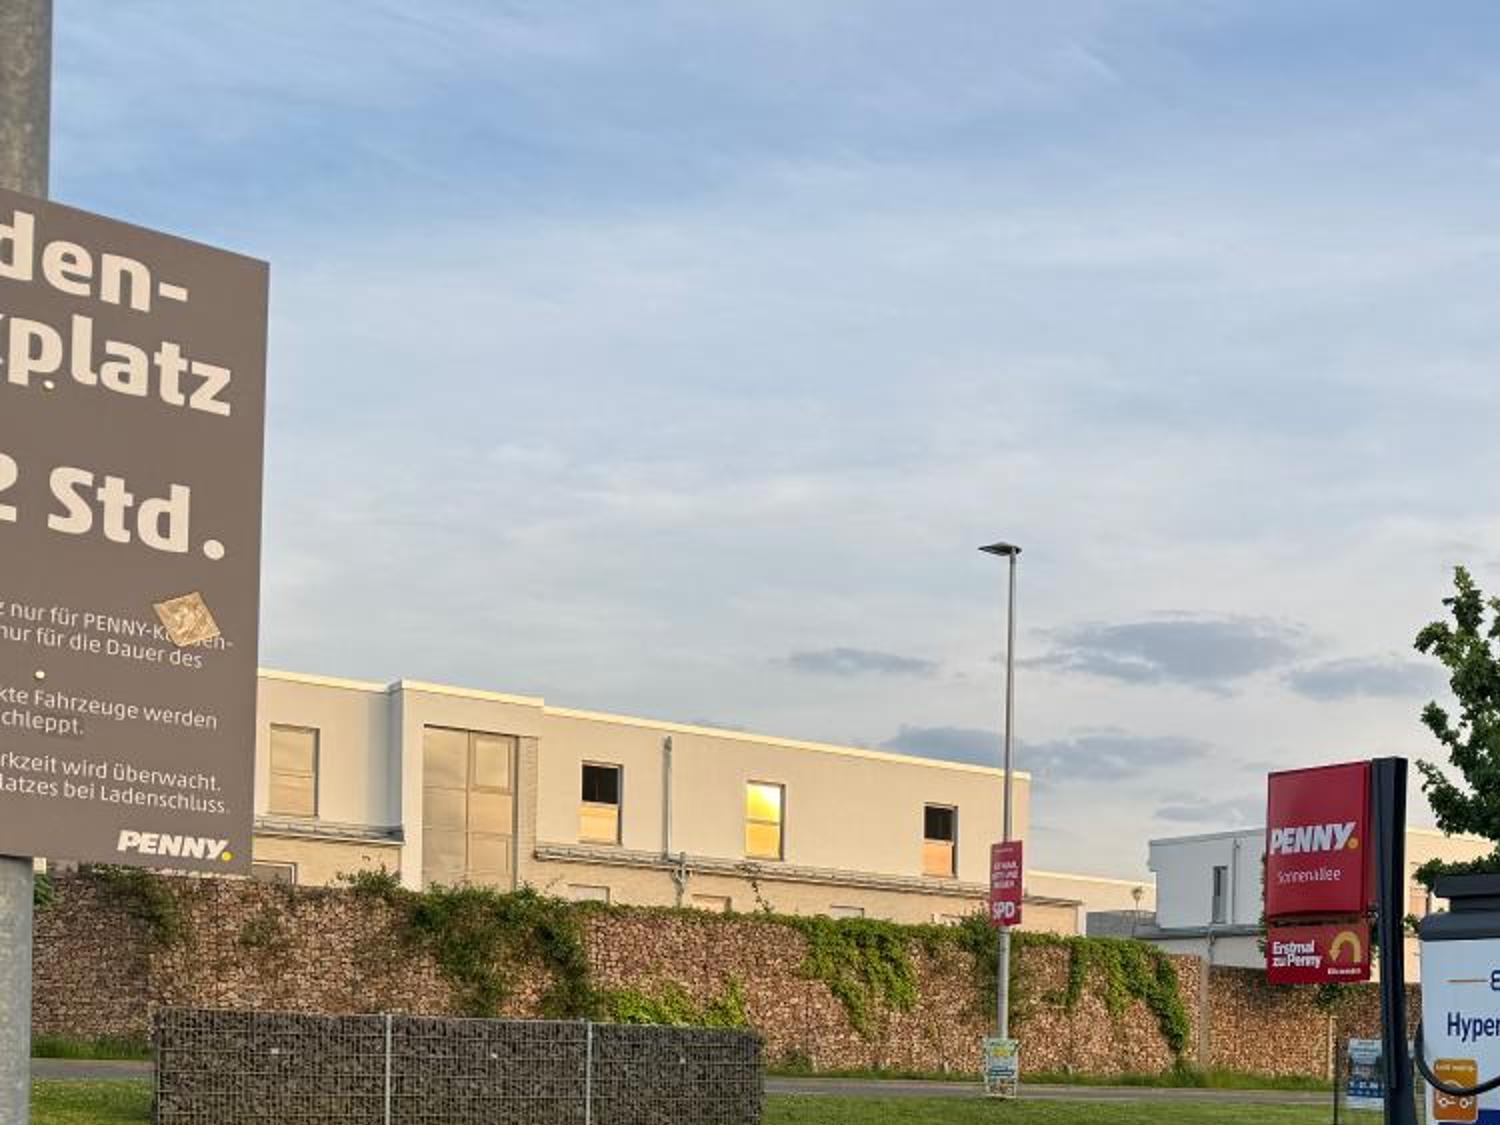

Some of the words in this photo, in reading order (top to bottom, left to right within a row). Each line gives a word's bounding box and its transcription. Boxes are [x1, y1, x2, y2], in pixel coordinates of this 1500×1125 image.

[0, 314, 231, 416] platz
[48, 466, 225, 560] Std.
[11, 603, 46, 621] nur
[50, 606, 79, 627] für
[36, 627, 65, 647] für
[69, 633, 101, 653] die
[107, 638, 166, 662] Dauer
[169, 649, 203, 668] des
[1, 709, 84, 736] chleppt.
[35, 689, 139, 720] Fahrzeuge
[143, 706, 218, 730] werden
[62, 759, 107, 779] wird
[113, 762, 221, 791] überwacht.
[63, 779, 95, 800] bei
[100, 785, 230, 814] Ladenschluss.
[992, 901, 1015, 920] SPD
[1272, 940, 1315, 955] Erstmal
[1287, 953, 1322, 968] Penny
